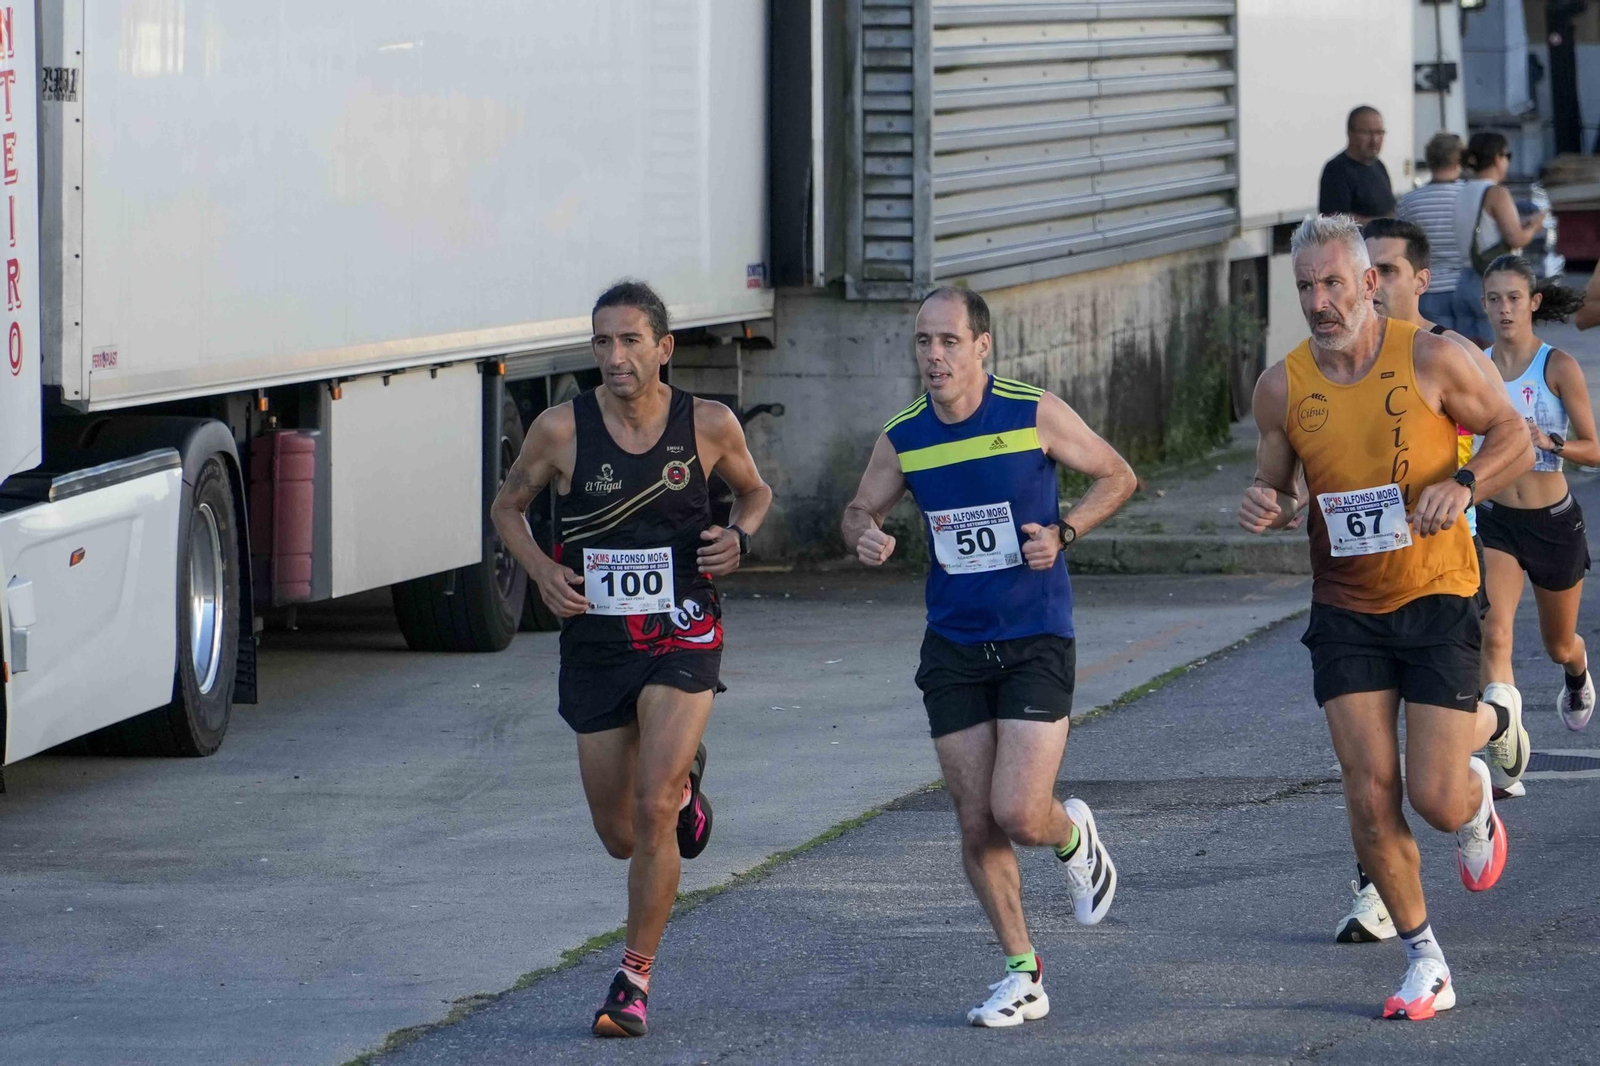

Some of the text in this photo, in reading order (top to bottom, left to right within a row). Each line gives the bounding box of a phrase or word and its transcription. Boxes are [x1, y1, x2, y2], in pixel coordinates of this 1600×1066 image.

[1300, 406, 1326, 419] Cibus
[585, 480, 622, 493] El Trigal
[1343, 492, 1375, 505] ALFONSO
[1376, 487, 1398, 500] MORO
[930, 506, 1008, 525] 10KMS ALFONSO MORO
[1346, 508, 1384, 537] 67
[956, 526, 996, 555] 50
[611, 554, 646, 563] ALFONSO
[601, 571, 663, 597] 100
